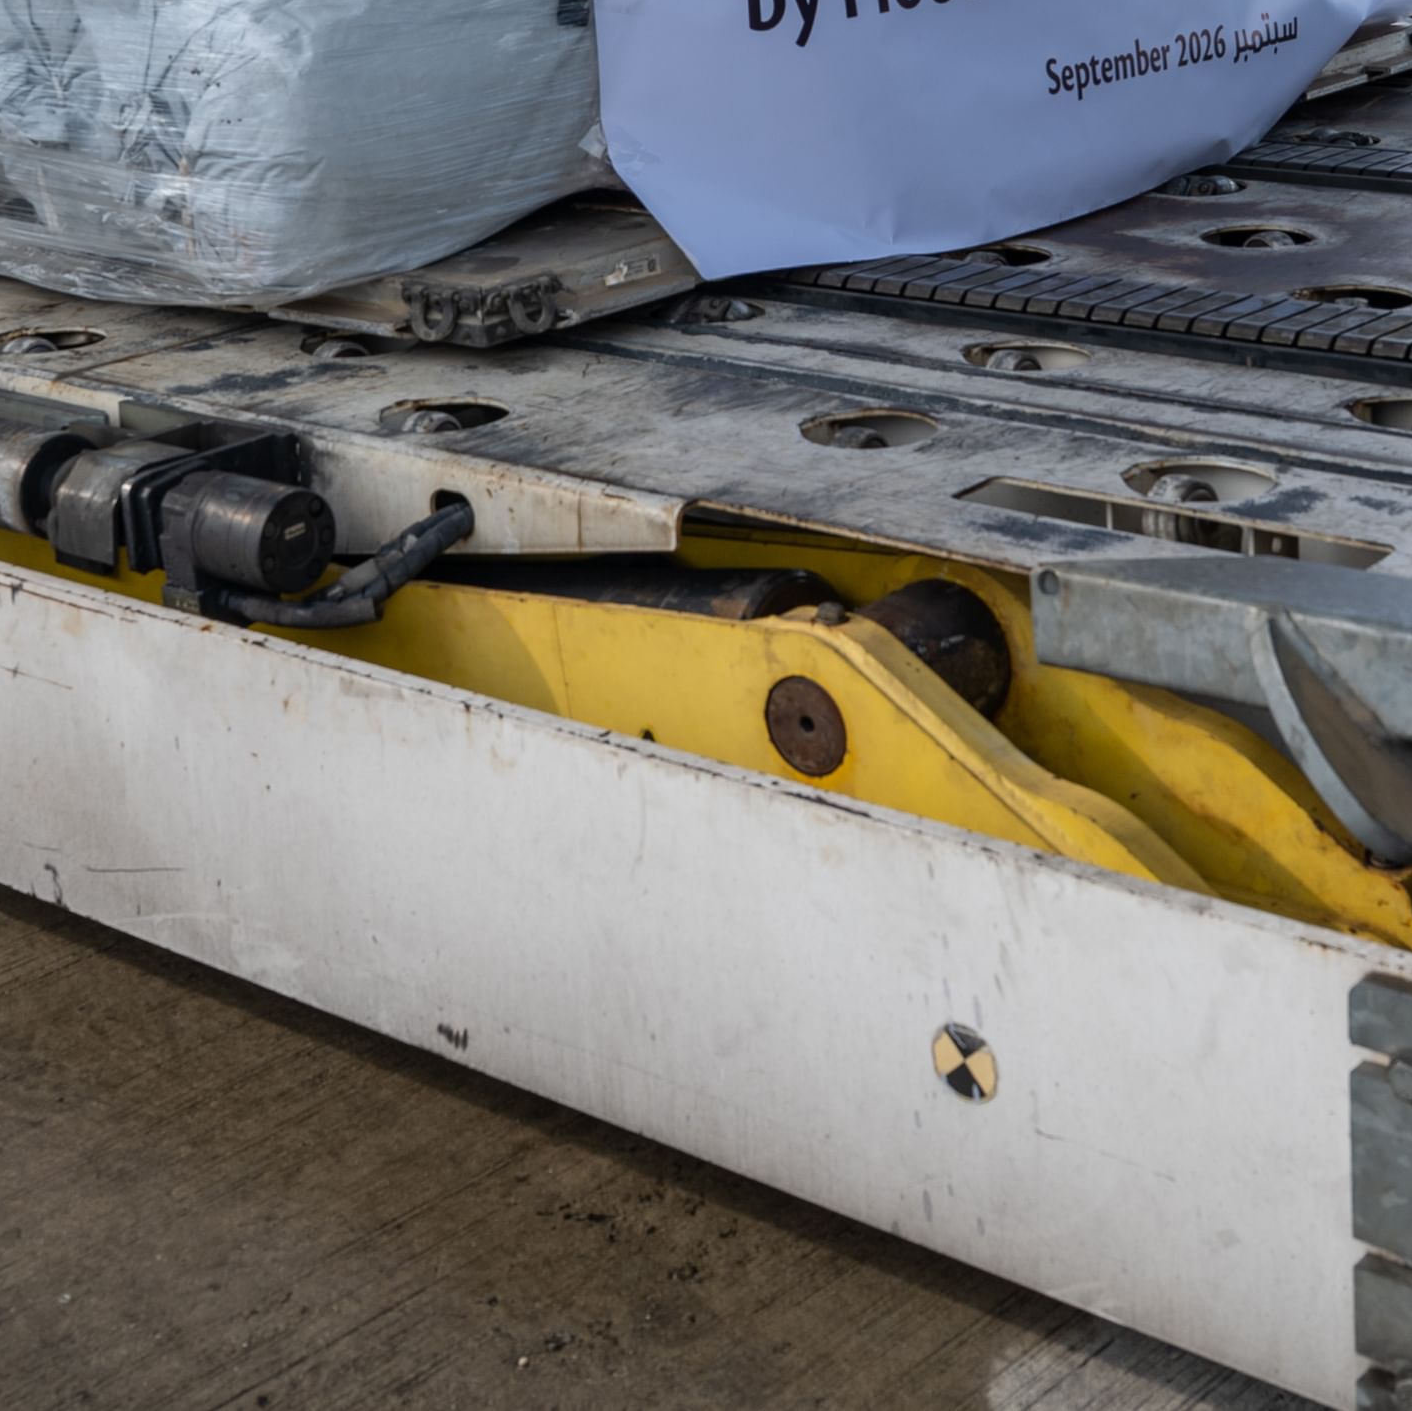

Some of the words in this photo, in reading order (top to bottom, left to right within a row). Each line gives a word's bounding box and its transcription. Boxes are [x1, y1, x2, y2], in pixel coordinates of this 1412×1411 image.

[1046, 38, 1170, 101] September
[1175, 25, 1226, 68] 2026
[1233, 12, 1298, 63] سبتمبر
